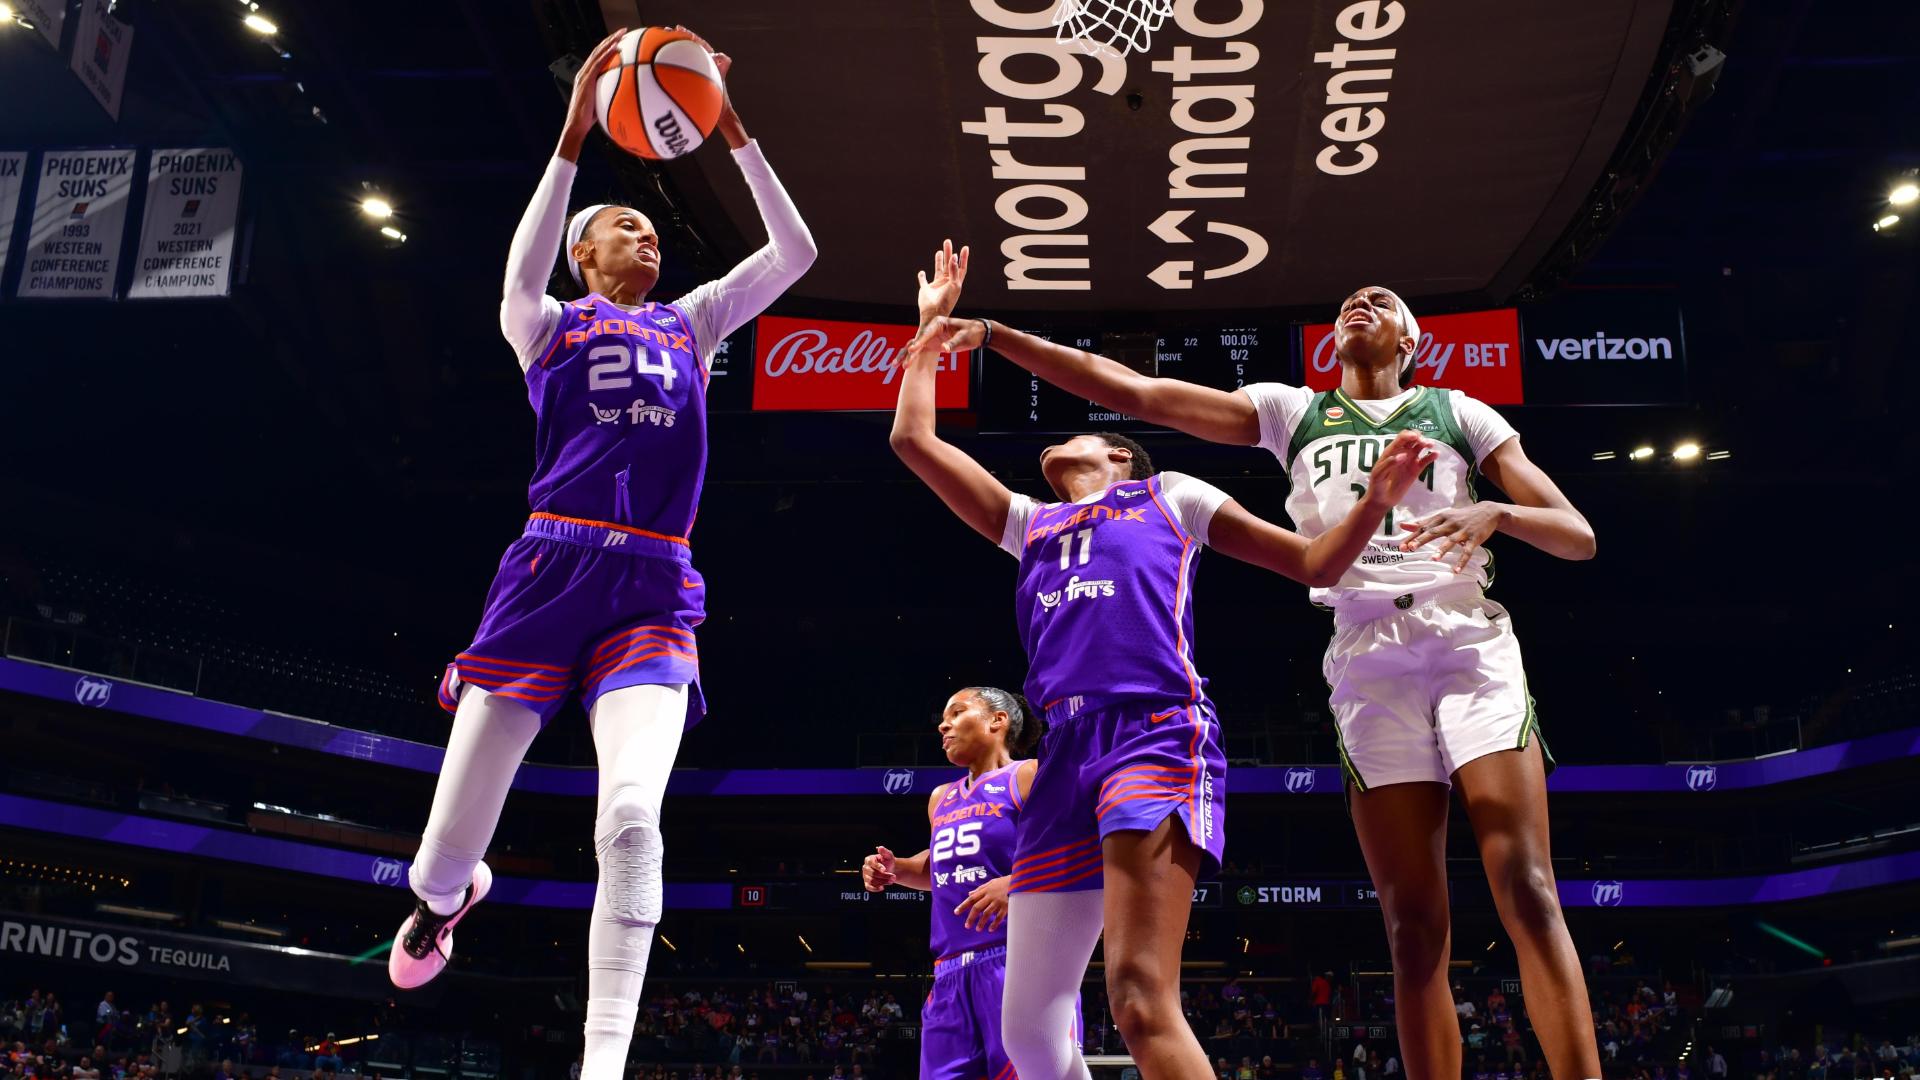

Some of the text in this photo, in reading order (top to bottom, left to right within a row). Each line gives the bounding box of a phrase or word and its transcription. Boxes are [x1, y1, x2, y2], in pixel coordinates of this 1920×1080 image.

[47, 157, 128, 176] PHOENIX
[158, 154, 236, 173] PHOENIX
[58, 180, 108, 197] SUNS
[170, 177, 217, 195] SUNS
[62, 225, 90, 238] 1993
[173, 223, 202, 236] 2021
[43, 242, 102, 255] WESTERN
[157, 239, 213, 252] WESTERN
[30, 259, 110, 273] CONFERENCE
[143, 257, 222, 270] CONFERENCE
[30, 276, 103, 290] CHAMPIONS
[145, 274, 215, 287] CHAMPIONS
[565, 319, 691, 353] PHOENIX
[1076, 339, 1091, 347] 6/8
[1184, 338, 1198, 346] 2/2
[1220, 334, 1259, 346] 100.0%
[1536, 332, 1673, 361] verizon
[764, 329, 898, 384] Bally
[1230, 349, 1249, 360] 8/2
[1465, 343, 1509, 367] BET
[588, 345, 678, 391] 24
[1236, 364, 1244, 375] 5
[1031, 380, 1039, 391] 5
[1031, 395, 1038, 407] 3
[626, 399, 677, 427] fry's
[1030, 410, 1038, 421] 4
[1088, 413, 1121, 421] SECOND
[1313, 438, 1434, 492] STOM
[1028, 505, 1147, 548] PHOENIX
[1058, 527, 1093, 571] 11
[1361, 553, 1404, 565] SWEDISH
[1065, 575, 1115, 602] fry's
[1205, 771, 1214, 840] MERCURY
[933, 802, 1004, 827] PHOENIX
[933, 822, 983, 863] 25
[952, 864, 988, 884] fry's
[748, 891, 759, 901] 10
[841, 891, 870, 901] FOULS 0
[886, 891, 925, 901] TIMEOUTS 5
[1258, 887, 1321, 902] STORM
[1357, 889, 1363, 900] 5
[0, 921, 230, 971] RNITOS TEQUILA
[1505, 983, 1519, 992] 121
